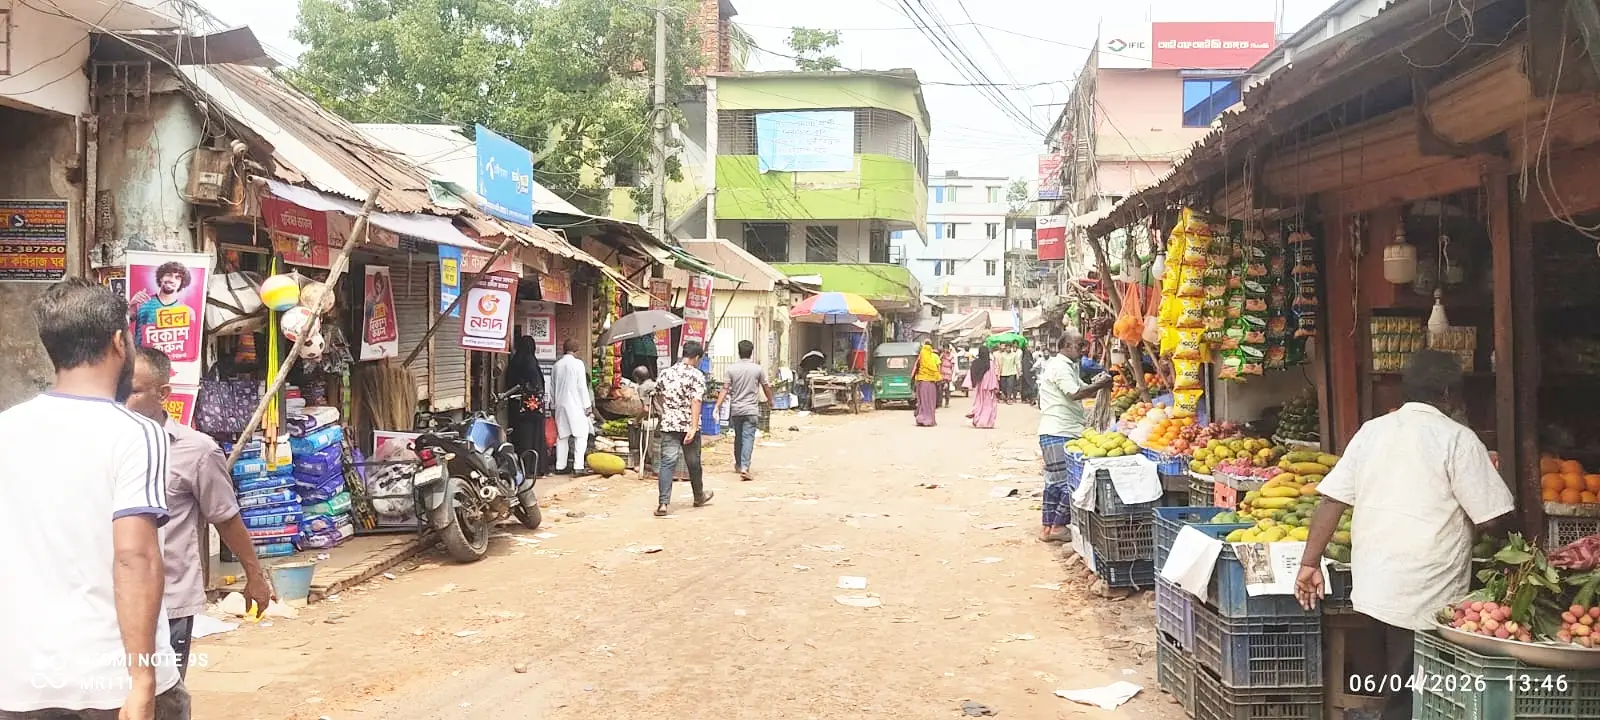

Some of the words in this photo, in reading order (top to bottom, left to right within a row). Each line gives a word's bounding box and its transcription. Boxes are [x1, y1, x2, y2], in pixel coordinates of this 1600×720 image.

[158, 309, 187, 327] বিল
[470, 316, 503, 330] নগদ
[145, 326, 190, 344] বিকাশ
